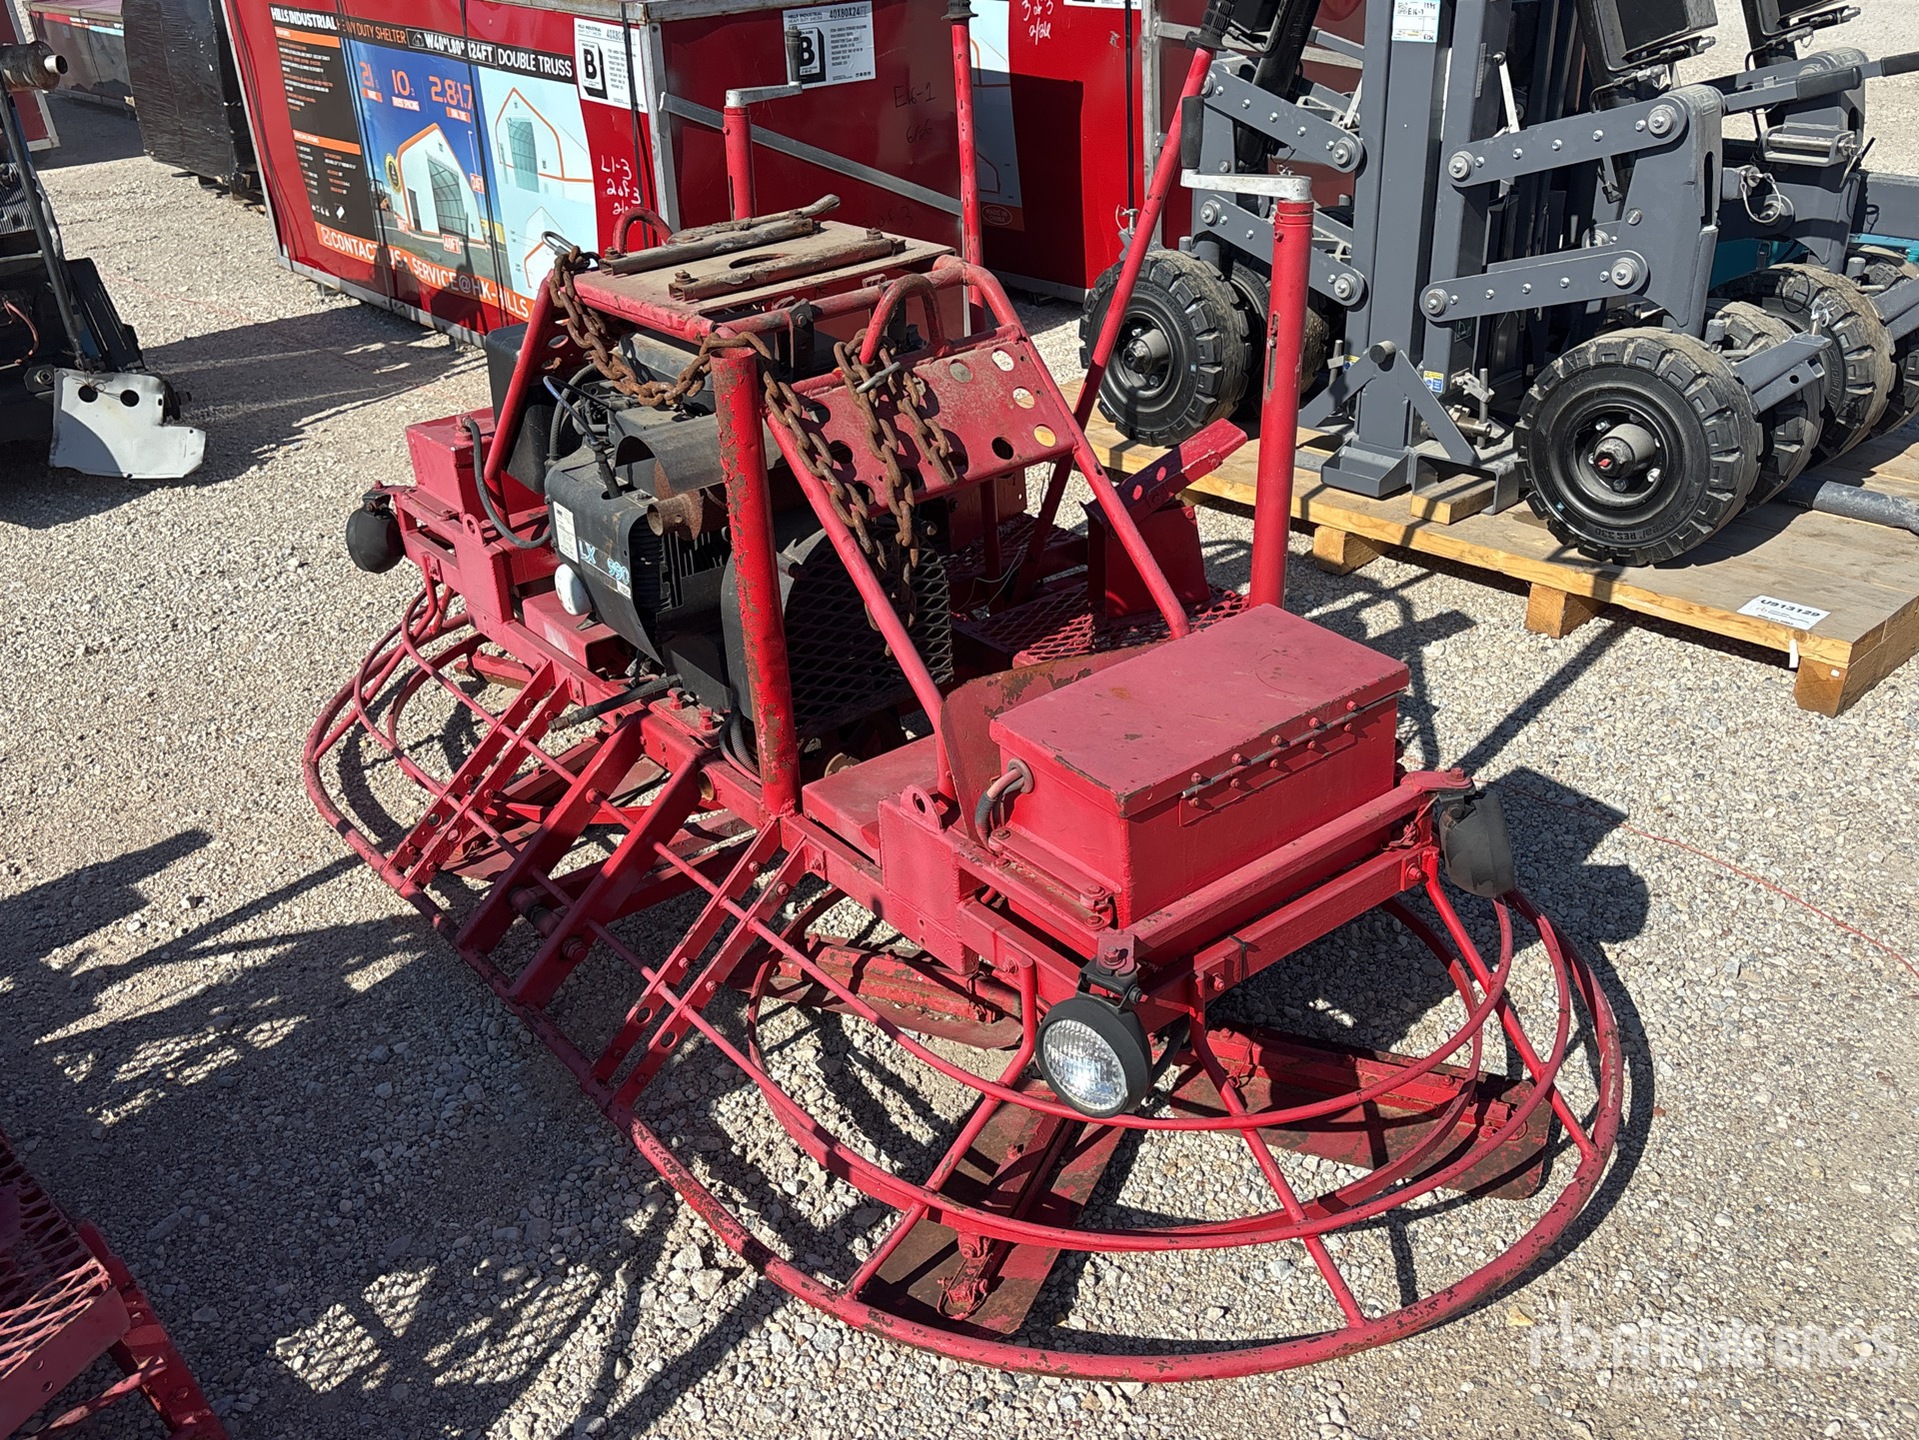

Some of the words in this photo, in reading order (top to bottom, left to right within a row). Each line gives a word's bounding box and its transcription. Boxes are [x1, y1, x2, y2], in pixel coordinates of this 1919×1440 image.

[270, 7, 289, 23] HILLS
[289, 10, 338, 31] INDUSTRIAL
[356, 22, 374, 39] DUTY
[375, 26, 407, 45] SHELTER
[498, 48, 537, 72] DOUBLE
[537, 55, 573, 78] TRUSS
[584, 48, 598, 80] B
[391, 69, 410, 96] 10
[578, 540, 596, 564] LX
[607, 558, 630, 585] 990
[1760, 599, 1820, 617] U913129
